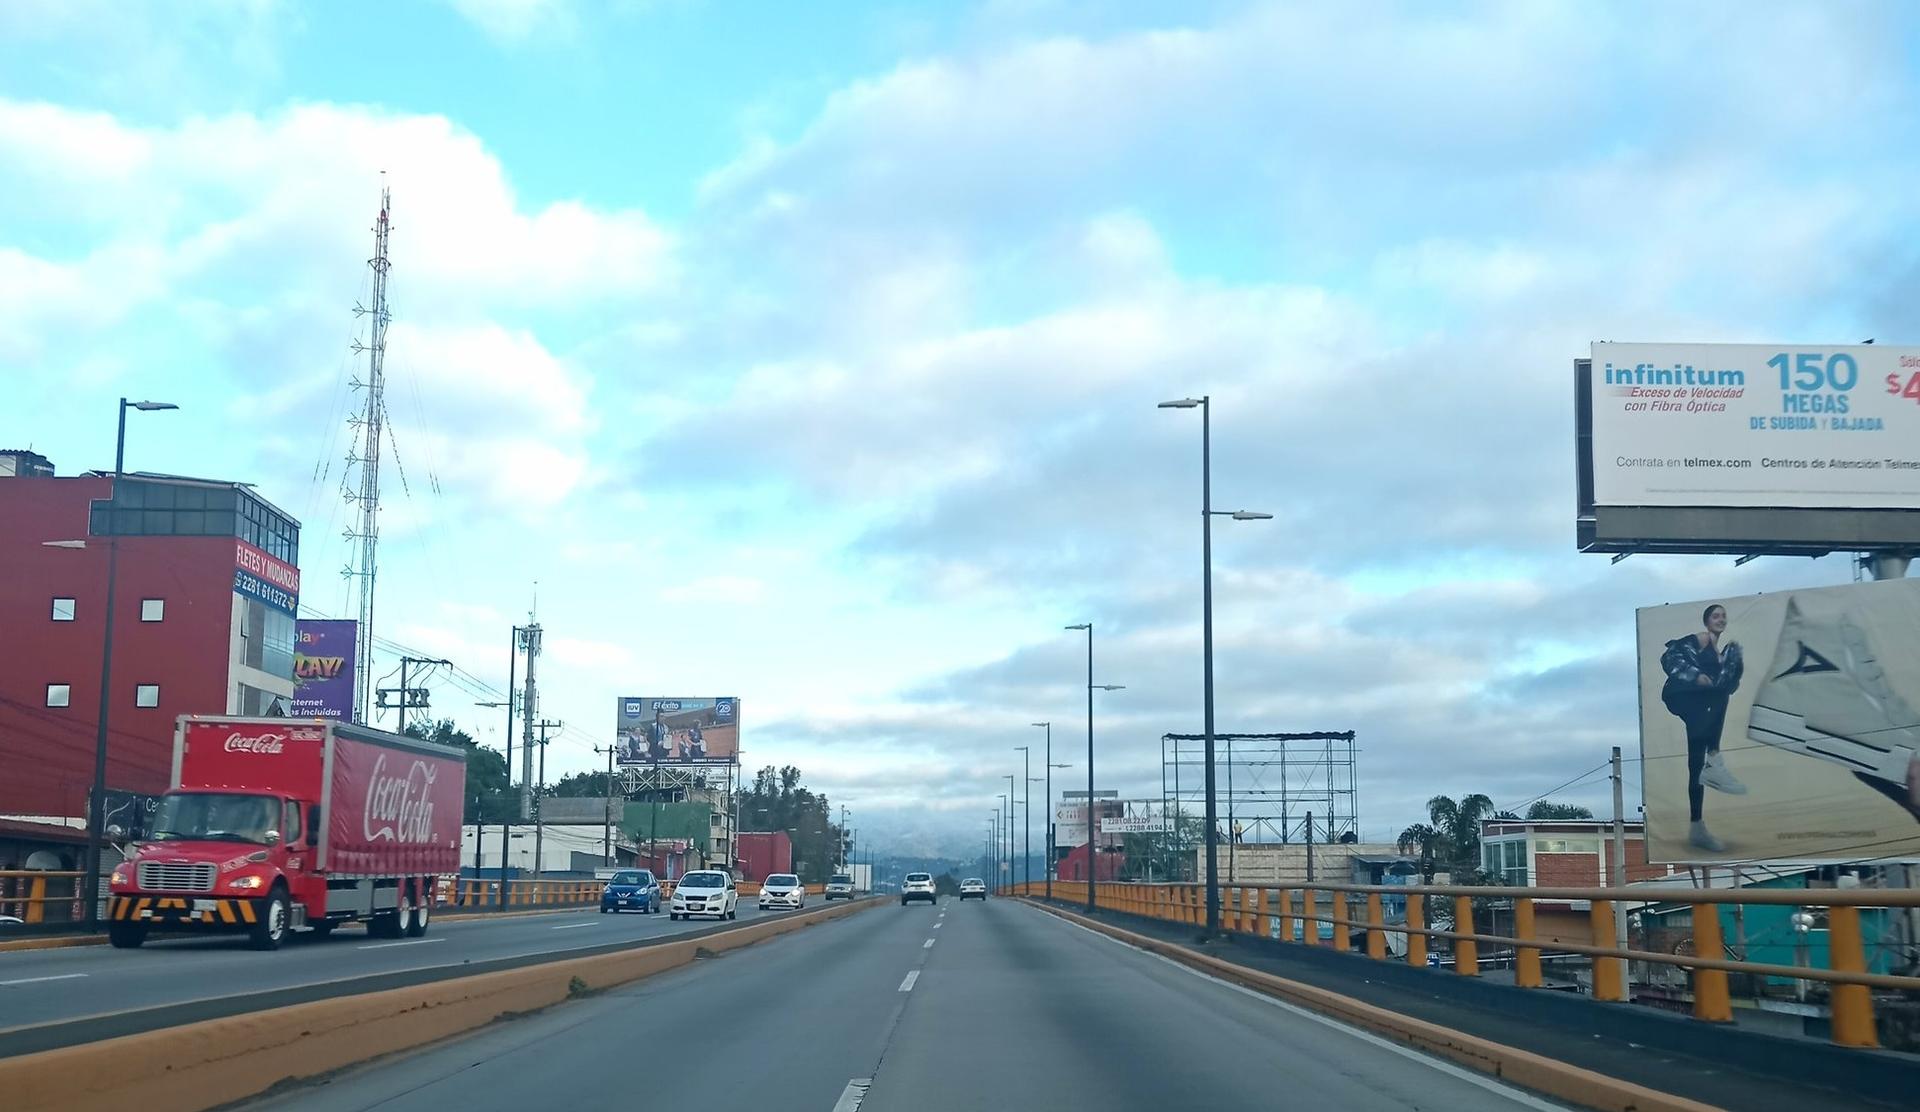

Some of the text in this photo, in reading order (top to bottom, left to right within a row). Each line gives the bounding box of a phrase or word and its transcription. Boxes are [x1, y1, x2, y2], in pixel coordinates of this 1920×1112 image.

[1605, 363, 1745, 385] infinitum
[1767, 353, 1858, 391] 150
[1631, 387, 1745, 398] Exceso de Velocidad
[1885, 371, 1920, 405] $4
[1624, 400, 1726, 413] con Fibra Óptica
[1783, 394, 1849, 414] MEGAS
[1750, 417, 1767, 430] DE
[1770, 417, 1817, 430] SUBIDA
[1832, 418, 1884, 430] BAJADA
[1616, 456, 1663, 467] Contrata
[1667, 459, 1680, 467] en
[1684, 457, 1752, 468] telmex.com
[1761, 458, 1808, 468] Centros
[1811, 459, 1825, 468] de
[1884, 459, 1920, 470] Telme
[236, 544, 298, 591] FLETES Y MUDANZAS
[242, 575, 288, 608] 2281 611372
[301, 708, 342, 716] incluidas
